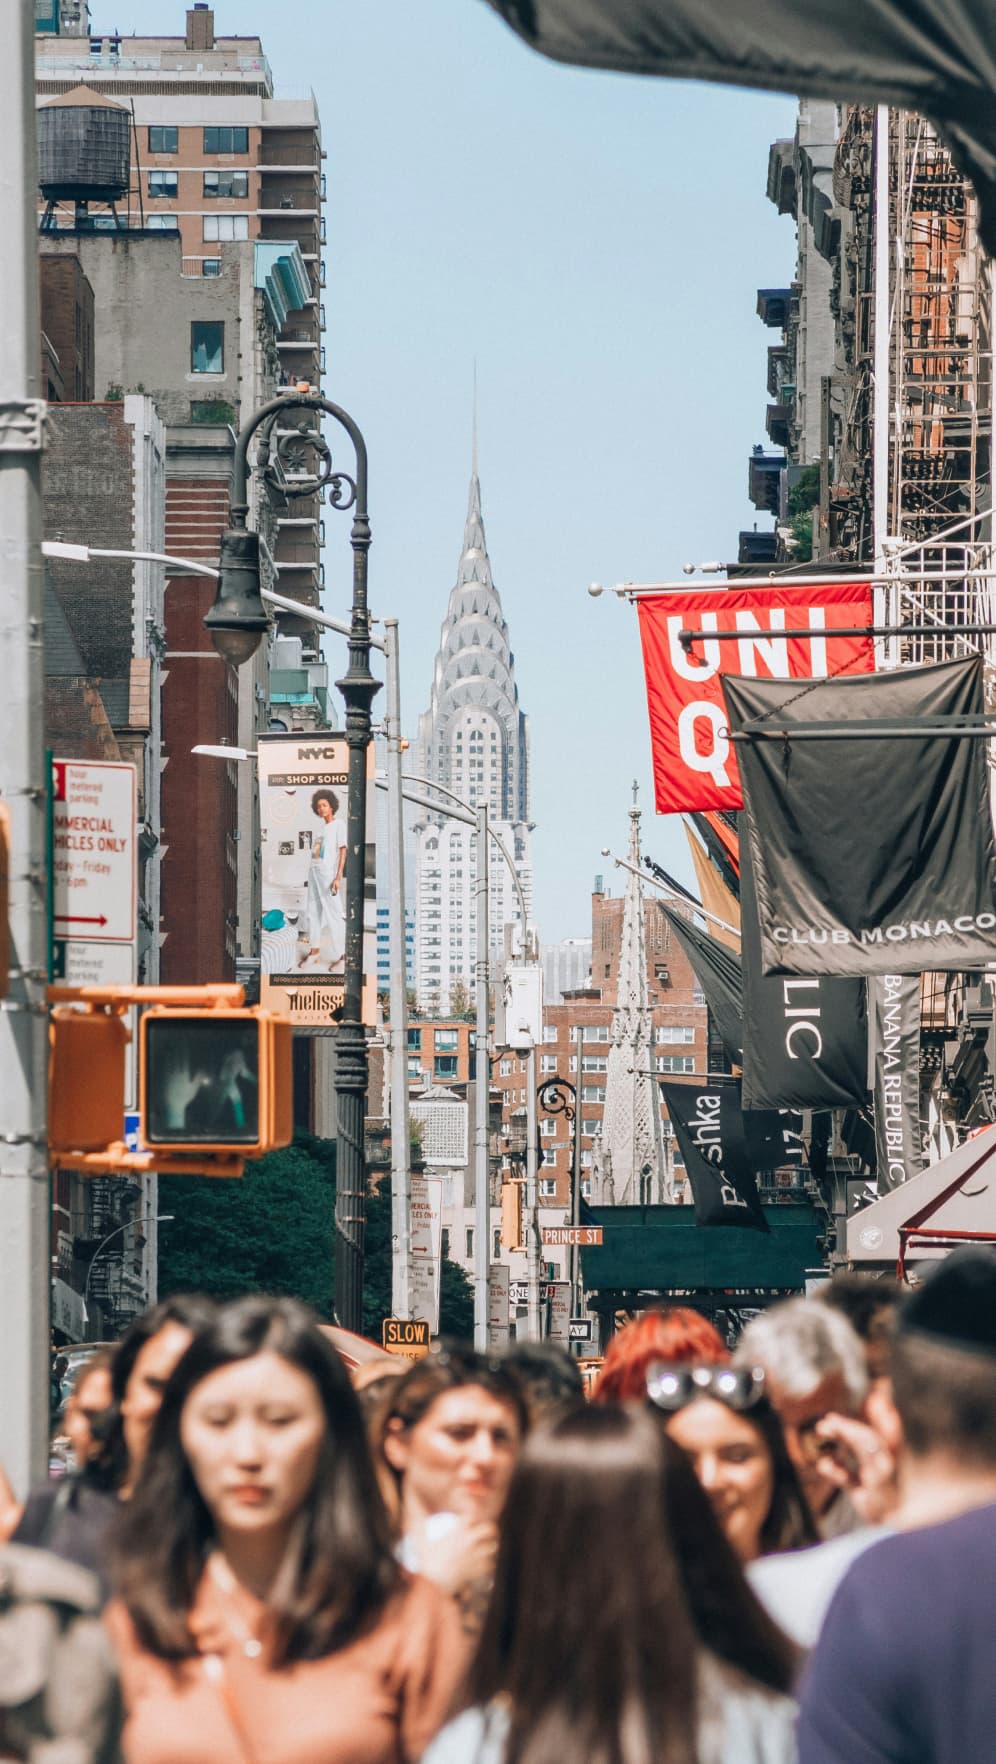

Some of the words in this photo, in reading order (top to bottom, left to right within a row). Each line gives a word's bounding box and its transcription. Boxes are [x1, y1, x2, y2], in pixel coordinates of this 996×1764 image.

[667, 607, 828, 682] UNI
[297, 747, 335, 760] NYC
[678, 700, 732, 787] Q
[286, 775, 316, 784] SHOP
[318, 774, 348, 784] SOHO
[97, 837, 127, 852] ONLY
[772, 926, 850, 945] CLUB
[861, 911, 996, 945] MONACO
[883, 974, 903, 1069] BANANA
[883, 1076, 906, 1183] REPUBLIC
[545, 1229, 580, 1244] PRINCE
[587, 1229, 599, 1243] ST
[509, 1288, 528, 1298] ONE
[388, 1323, 425, 1343] SLOW
